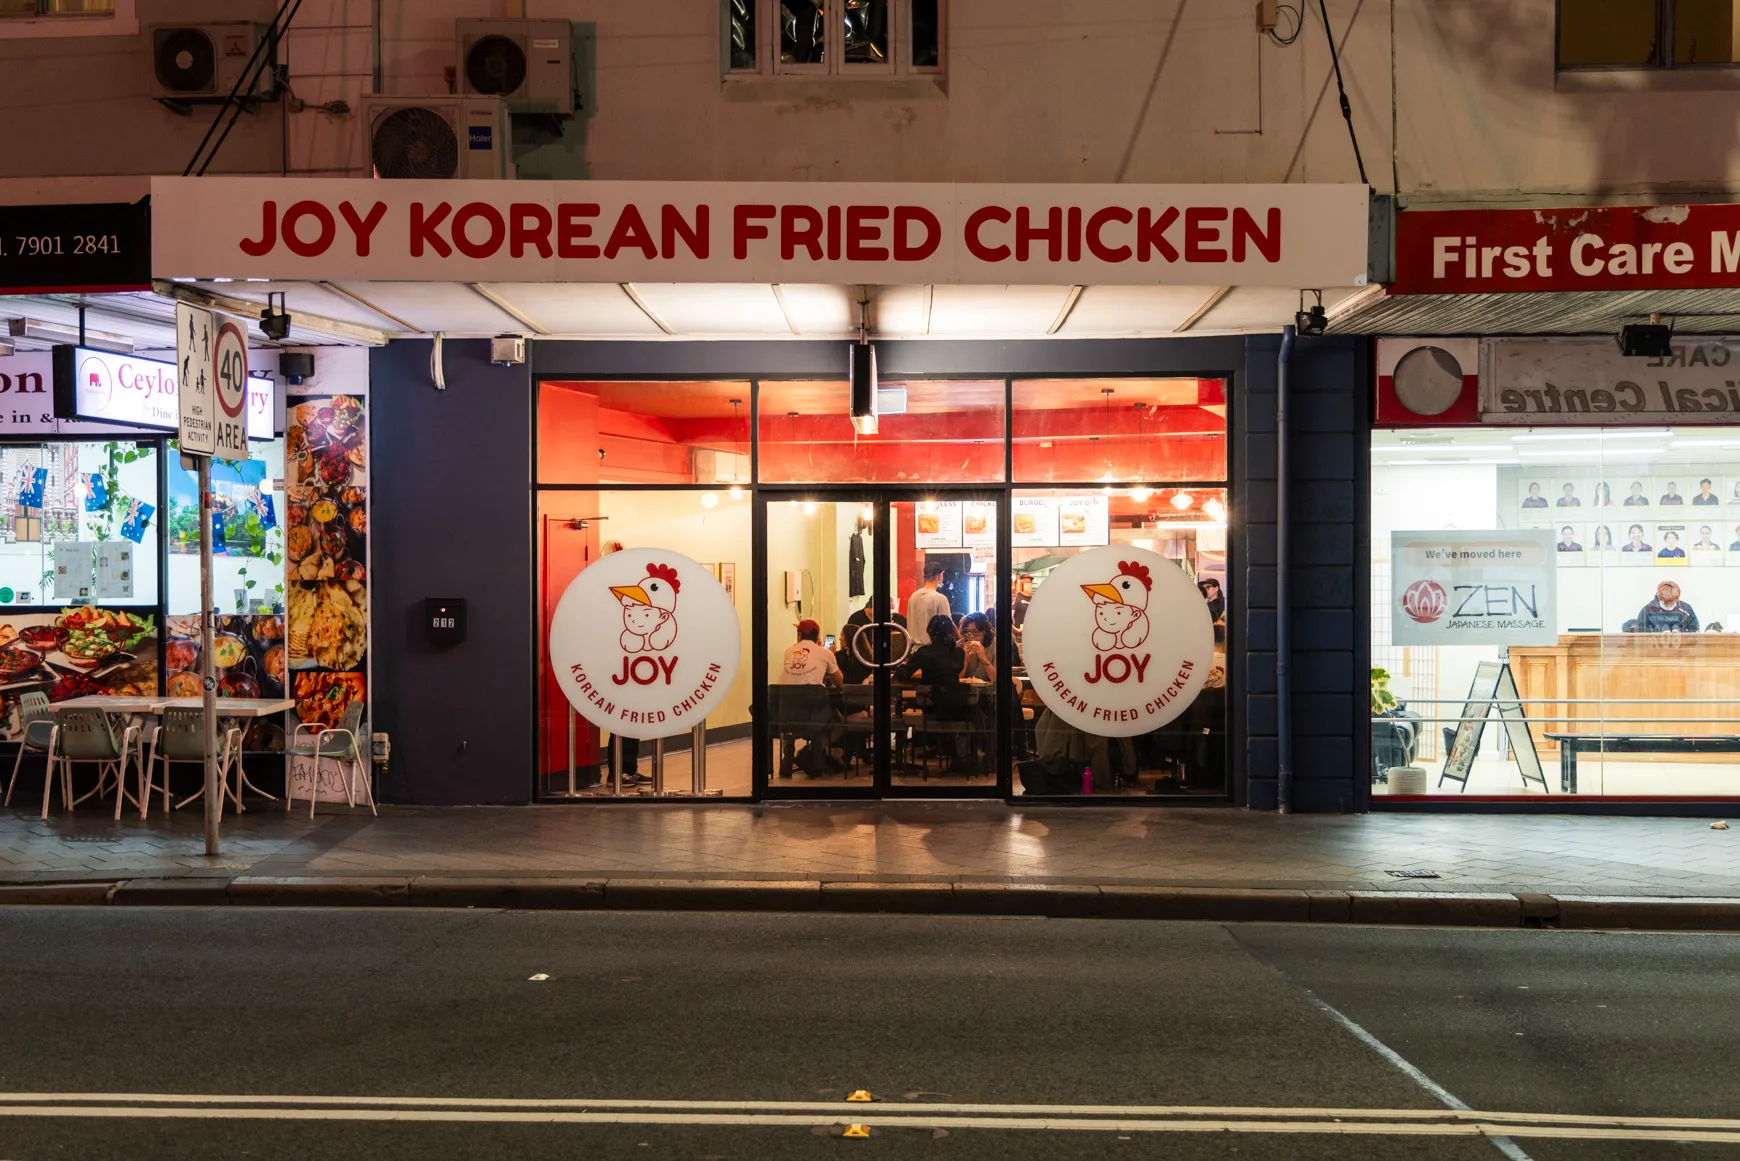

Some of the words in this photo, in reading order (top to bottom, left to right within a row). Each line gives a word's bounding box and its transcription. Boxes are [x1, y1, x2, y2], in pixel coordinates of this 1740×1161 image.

[469, 134, 492, 142] Haier
[239, 199, 388, 259] JOY
[409, 201, 711, 261] KOREAN
[733, 203, 942, 263] FRIED
[963, 205, 1281, 263] CHICKEN
[15, 235, 64, 256] 7901
[73, 234, 121, 255] 2841
[1433, 235, 1553, 279] First
[1569, 232, 1695, 277] Care
[1711, 230, 1740, 273] M
[117, 363, 178, 399] Ceylo
[220, 349, 243, 393] 40
[191, 405, 203, 416] HIGH
[249, 391, 269, 414] ry
[11, 410, 32, 423] in
[40, 413, 54, 423] &
[183, 416, 212, 430] PEDESTRIAN
[187, 431, 209, 444] ACTIVITY
[216, 421, 248, 451] AREA
[1425, 549, 1457, 559] We've
[1460, 548, 1495, 559] moved
[1498, 548, 1522, 559] here
[1453, 584, 1538, 619] ZEN
[433, 617, 455, 628] 212
[1445, 620, 1494, 629] JAPANESE
[1497, 620, 1546, 629] MASSAGE
[612, 655, 679, 685] JOY
[1084, 653, 1151, 684] JOY
[570, 663, 616, 715] KOREAN
[620, 709, 666, 724] FRIED
[672, 662, 721, 717] CHICKEN
[1043, 661, 1088, 713] KOREAN
[1093, 707, 1139, 722] FRIED
[1145, 660, 1194, 715] CHICKEN
